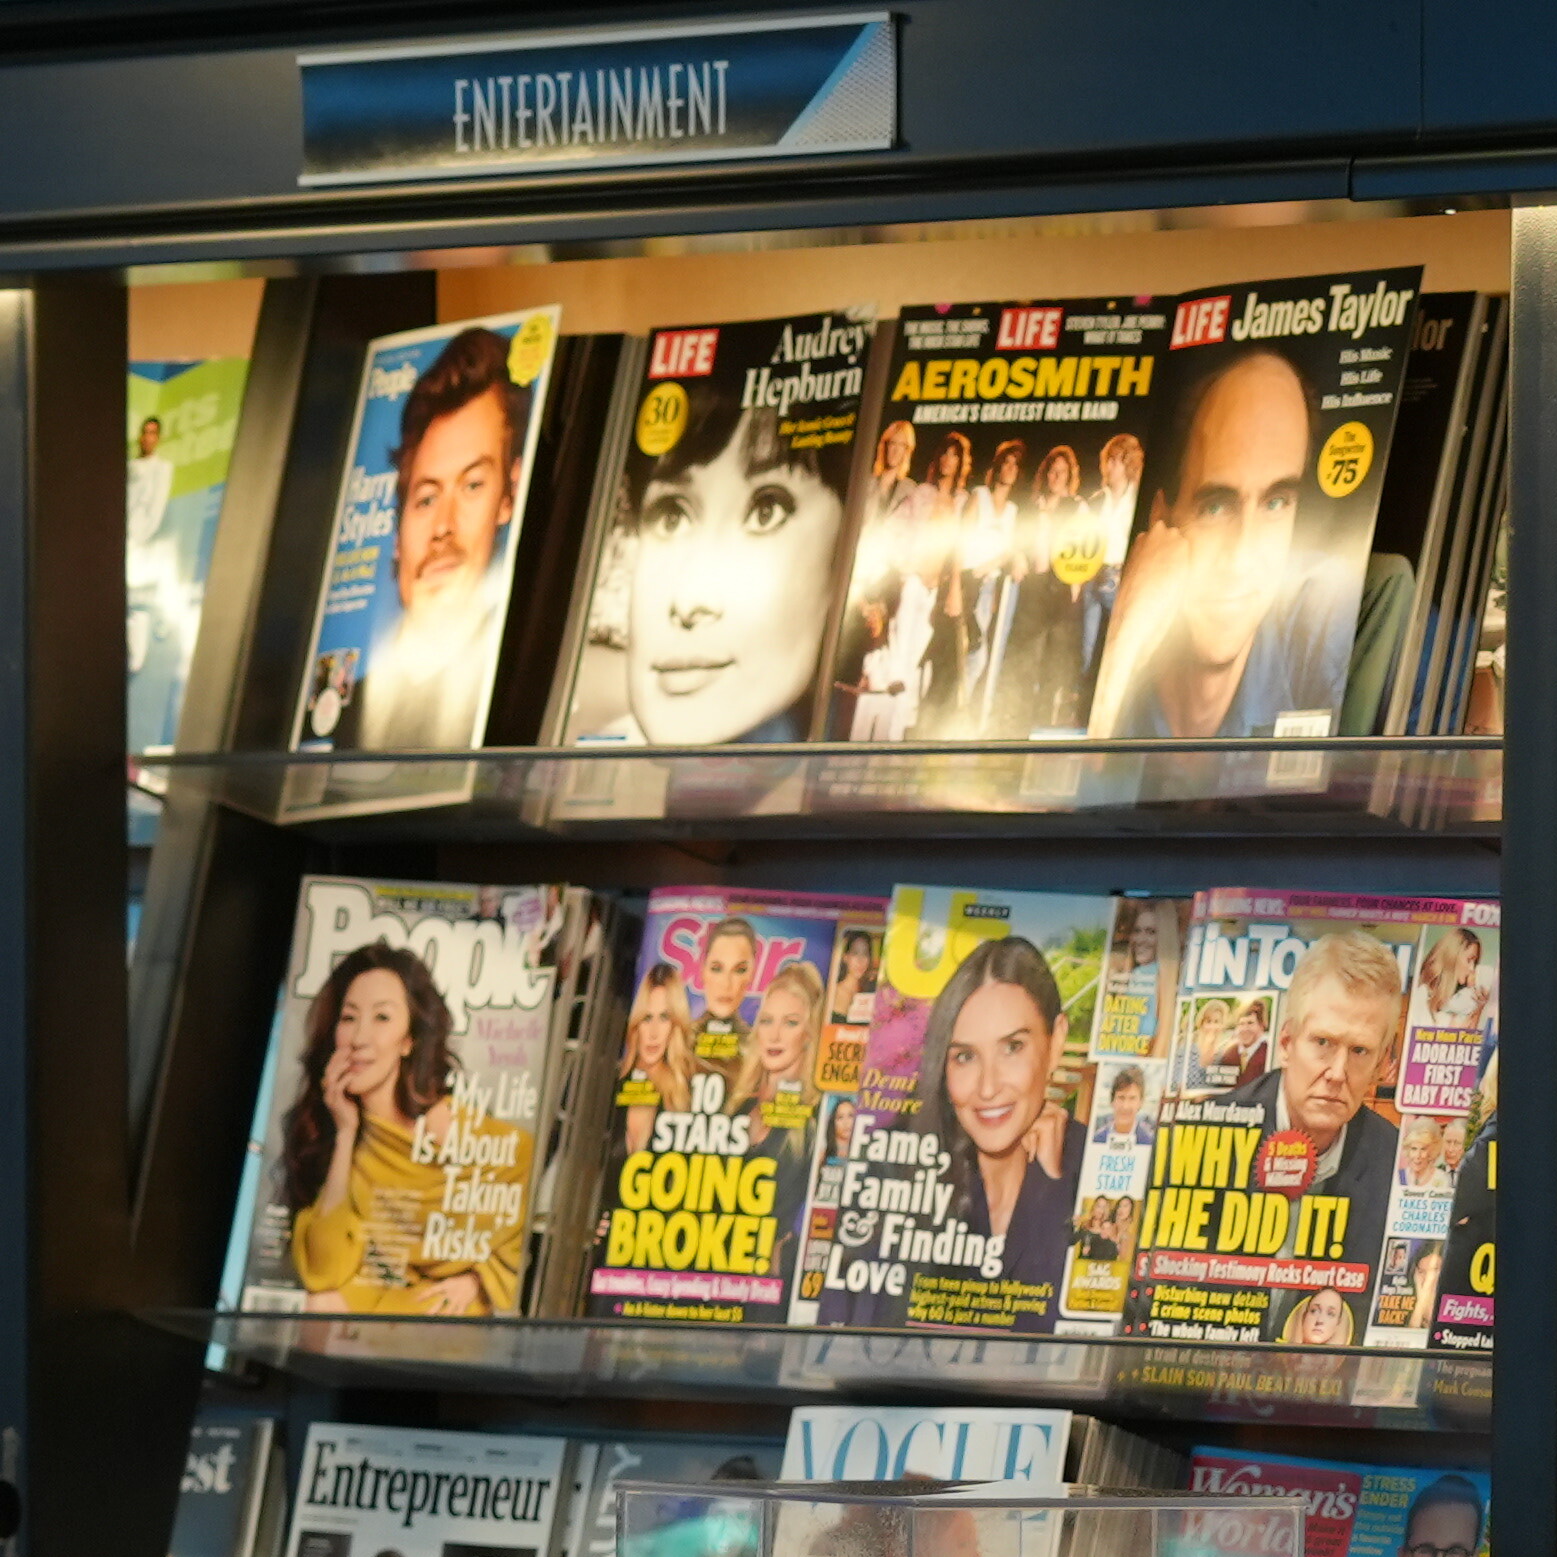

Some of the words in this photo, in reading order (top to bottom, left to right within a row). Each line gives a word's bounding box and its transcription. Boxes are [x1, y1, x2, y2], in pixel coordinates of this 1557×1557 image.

[453, 60, 729, 152] ENTERTAINMENT
[772, 320, 874, 365] Audrey
[1172, 297, 1230, 348] LIFE
[1233, 292, 1324, 340] James
[1329, 285, 1412, 333] Taylor
[742, 369, 862, 411] Hepburn
[892, 356, 1155, 401] AEROSMITH
[618, 1157, 776, 1219] GOING
[609, 1209, 772, 1274] BROKE!
[308, 1440, 550, 1527] Entrepreneur
